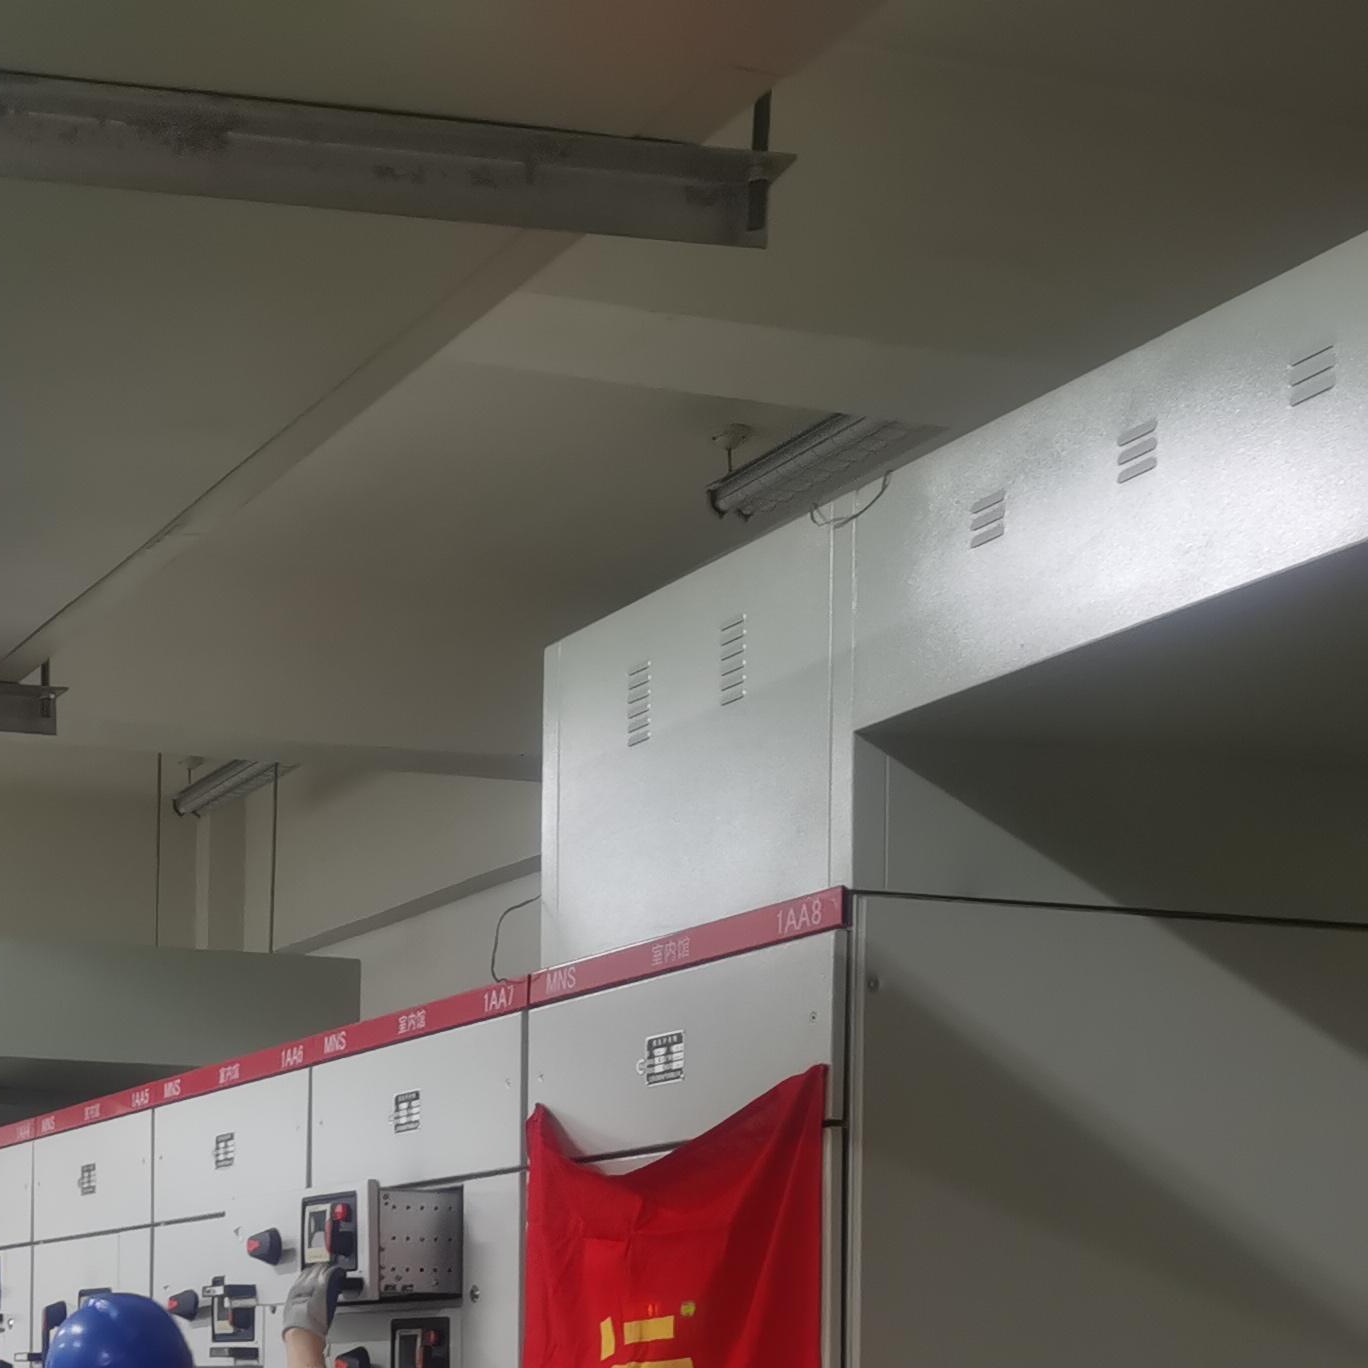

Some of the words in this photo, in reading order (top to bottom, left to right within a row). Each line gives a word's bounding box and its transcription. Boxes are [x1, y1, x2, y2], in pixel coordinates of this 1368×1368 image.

[545, 967, 577, 995] MNS
[776, 900, 823, 936] 1AA8
[323, 1031, 347, 1055] MNS
[484, 985, 515, 1013] 1AA7
[281, 1045, 304, 1069] 1AA6
